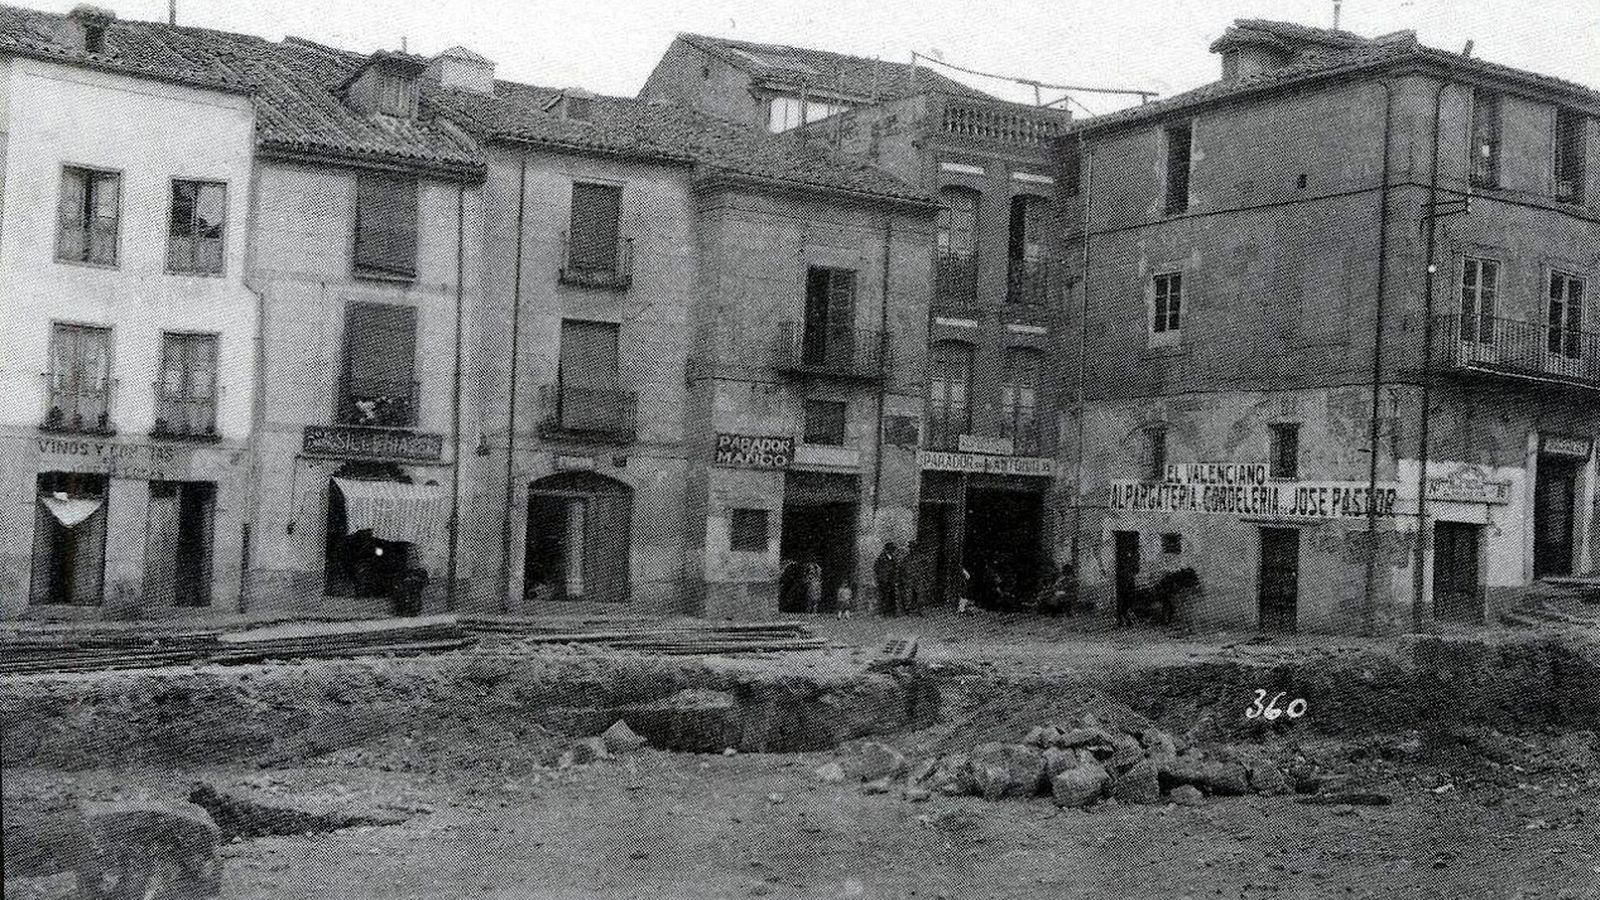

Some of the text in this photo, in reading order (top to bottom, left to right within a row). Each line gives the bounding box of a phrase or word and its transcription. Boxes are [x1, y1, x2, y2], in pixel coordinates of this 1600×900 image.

[38, 439, 89, 456] VINOS
[95, 442, 104, 457] Y
[719, 435, 791, 453] PARADOR
[923, 452, 974, 469] PARADOR
[1167, 463, 1265, 485] EL VALENCIANO
[1111, 484, 1196, 511] ALPARGATERIA
[1203, 486, 1279, 514] CORDELERIA
[1288, 487, 1328, 516] JOSE
[1333, 487, 1397, 518] PASTOR
